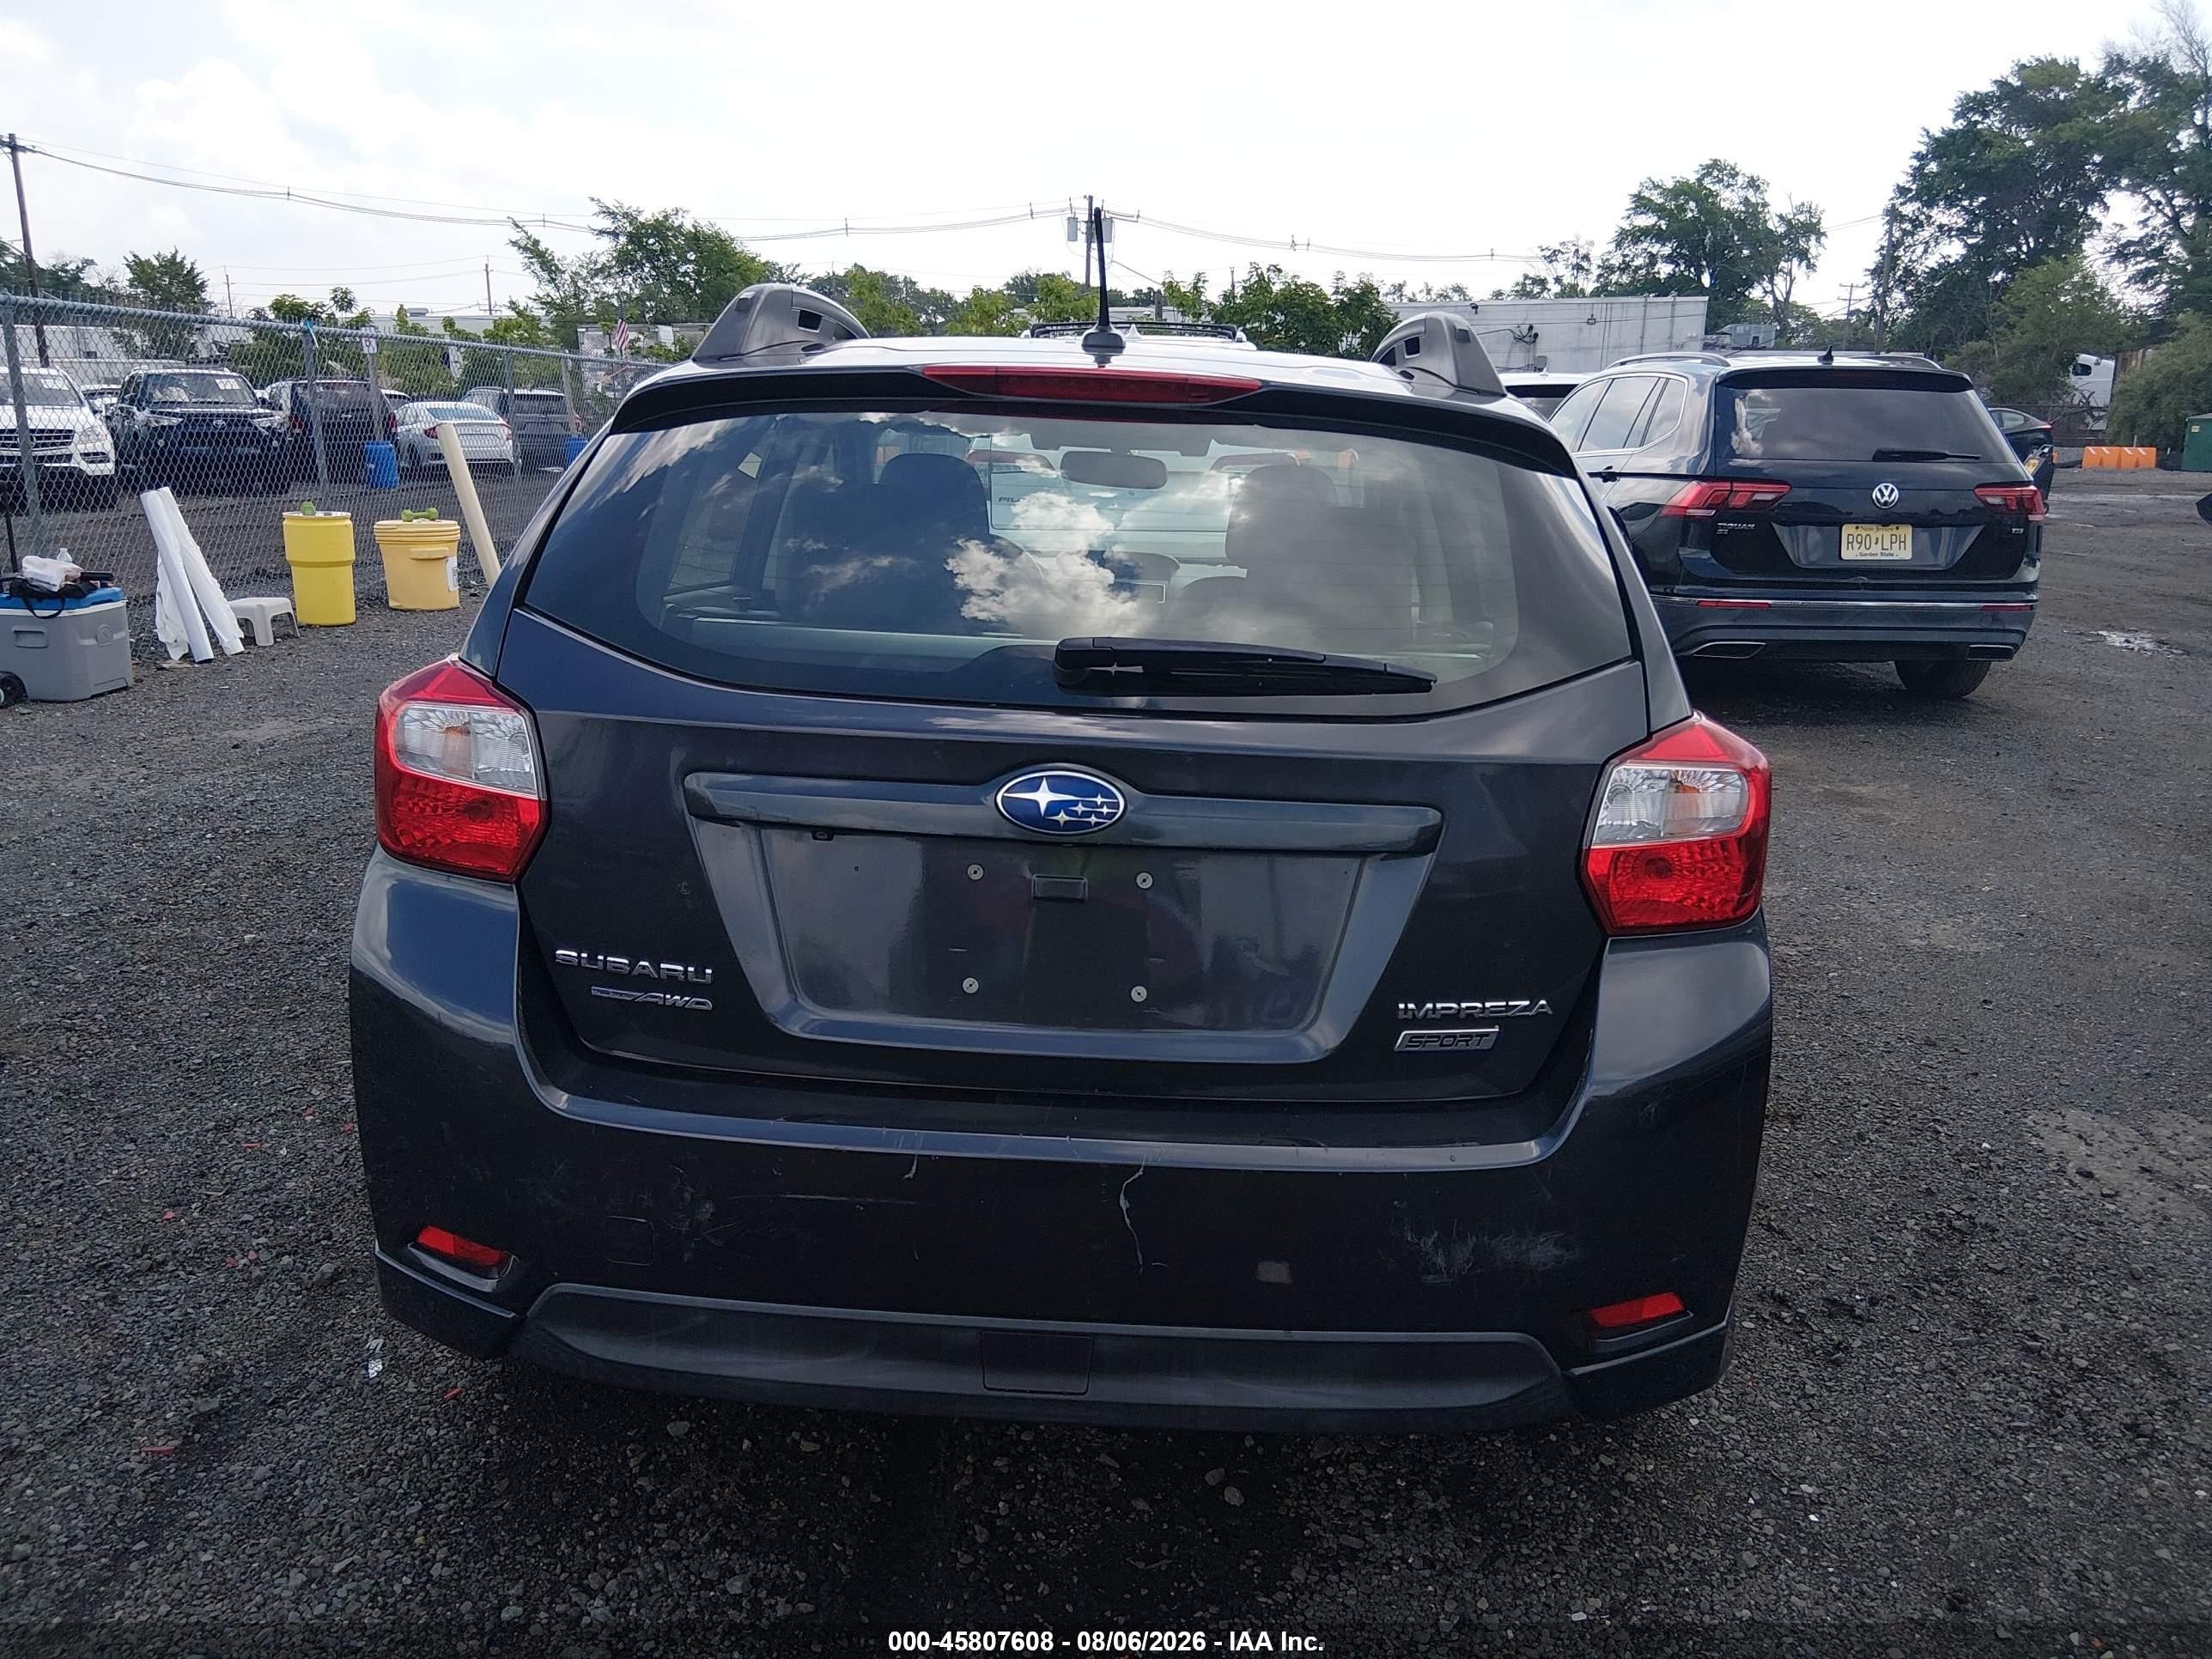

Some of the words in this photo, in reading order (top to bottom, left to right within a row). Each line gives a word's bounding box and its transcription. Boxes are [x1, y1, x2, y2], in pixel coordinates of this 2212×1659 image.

[555, 949, 713, 985] SUBARU
[634, 992, 714, 1011] AWD
[1397, 999, 1553, 1020] IMPREZA
[1405, 1033, 1491, 1048] SPORT
